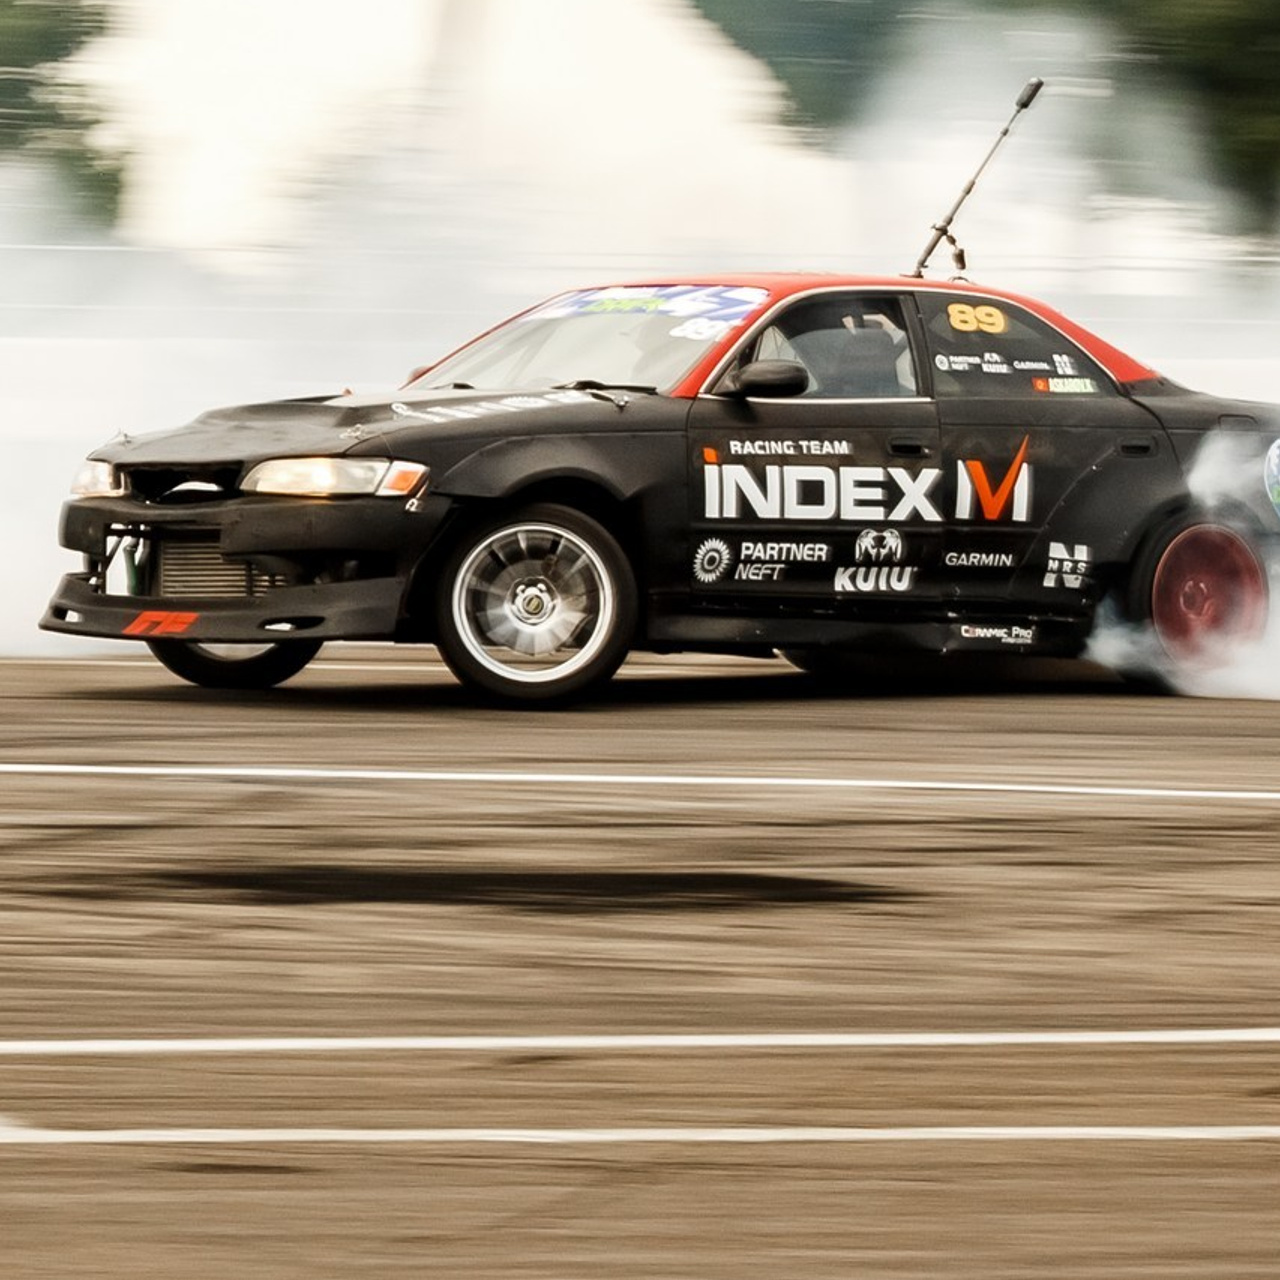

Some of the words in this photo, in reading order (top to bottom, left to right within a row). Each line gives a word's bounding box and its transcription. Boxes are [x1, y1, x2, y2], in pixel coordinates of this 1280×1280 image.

[947, 303, 1007, 334] 89
[730, 440, 796, 455] RACING
[799, 440, 852, 455] TEAM
[740, 542, 829, 562] PARTNER
[945, 552, 1013, 567] GARMIN
[734, 563, 785, 581] NEFT
[1047, 559, 1087, 573] NRS
[834, 567, 913, 591] KUIU
